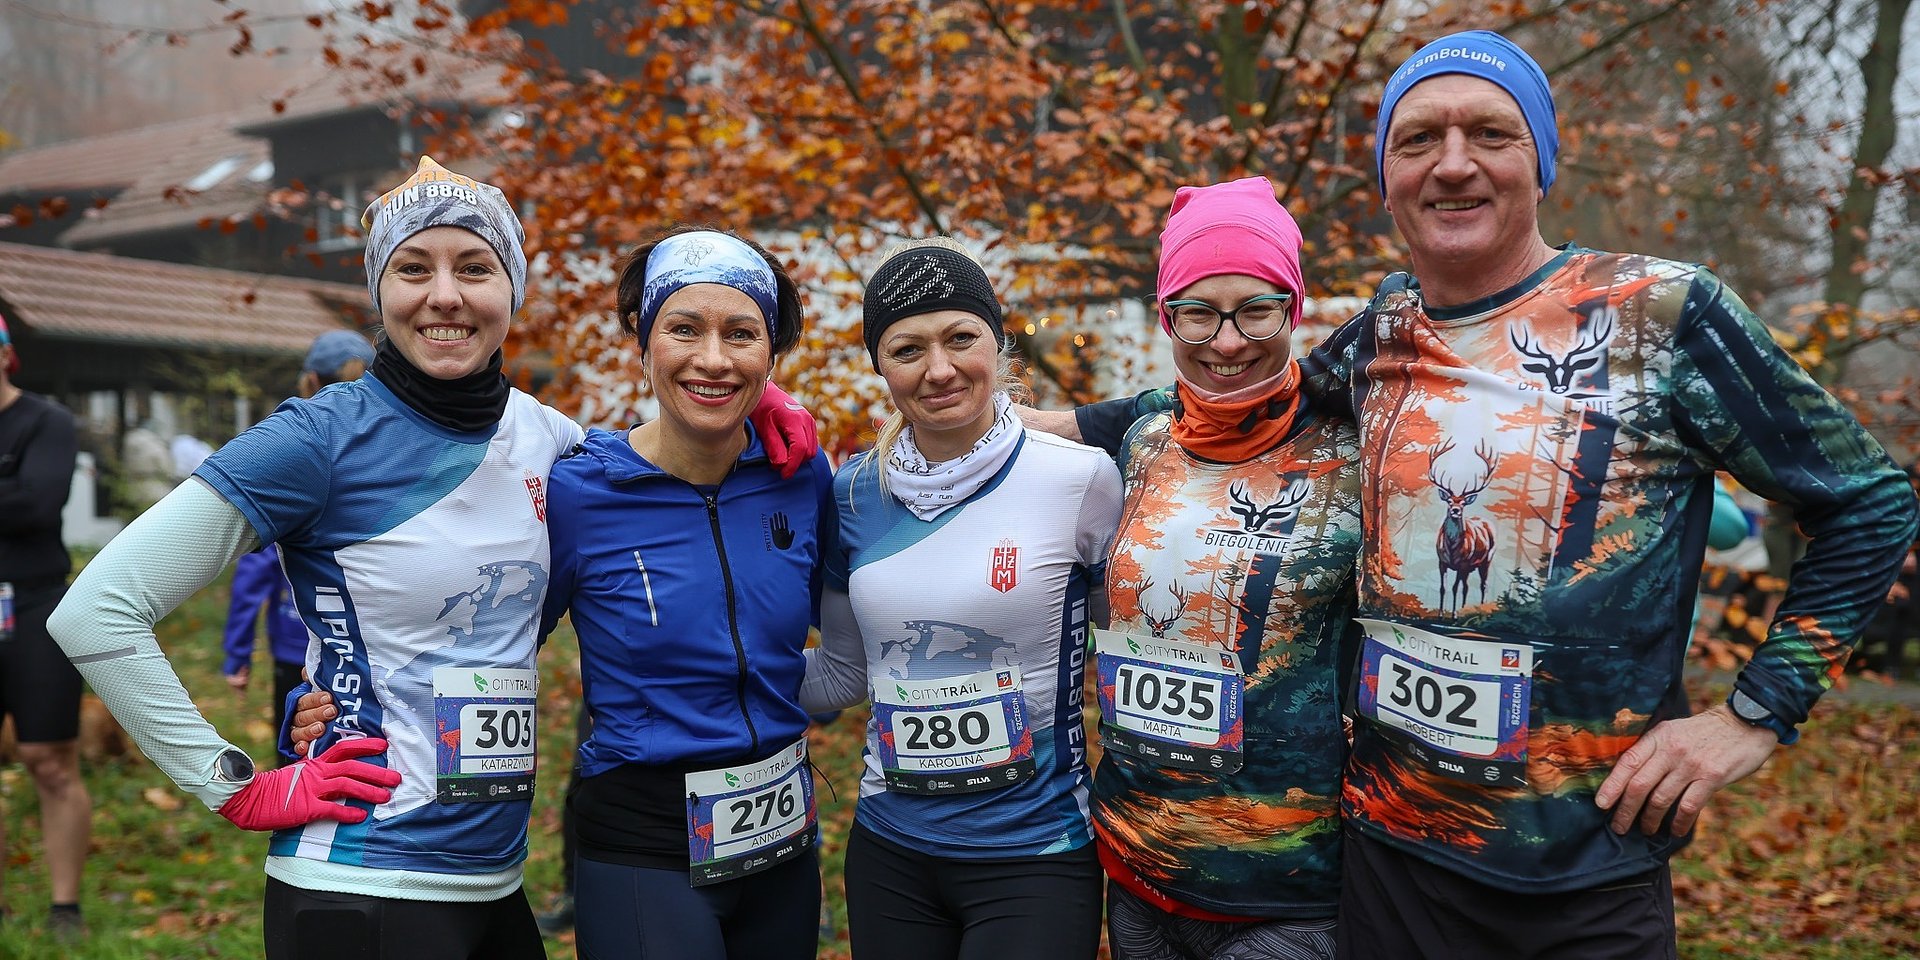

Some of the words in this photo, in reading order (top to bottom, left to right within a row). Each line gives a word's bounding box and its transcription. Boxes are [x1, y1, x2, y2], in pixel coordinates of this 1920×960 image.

[383, 185, 419, 227] RUN
[426, 184, 477, 205] 8848
[1204, 532, 1291, 554] BIEGOLENIE
[1119, 668, 1215, 721] 1035
[1229, 682, 1238, 719] SZCZECIN
[1389, 662, 1477, 729] 302
[1510, 683, 1522, 726] SZCZECIN
[475, 709, 531, 749] 303
[1012, 697, 1024, 731] SZCZECIN
[1142, 720, 1182, 738] MARTA
[901, 710, 990, 750] 280
[1404, 719, 1455, 747] ROBERT
[481, 758, 531, 770] KATARZYNA
[919, 753, 985, 770] KAROLINA
[1170, 752, 1195, 762] SILVA
[1438, 760, 1466, 774] SILVA
[966, 775, 991, 787] SILVA
[729, 782, 795, 835] 276
[751, 829, 783, 848] ANNA
